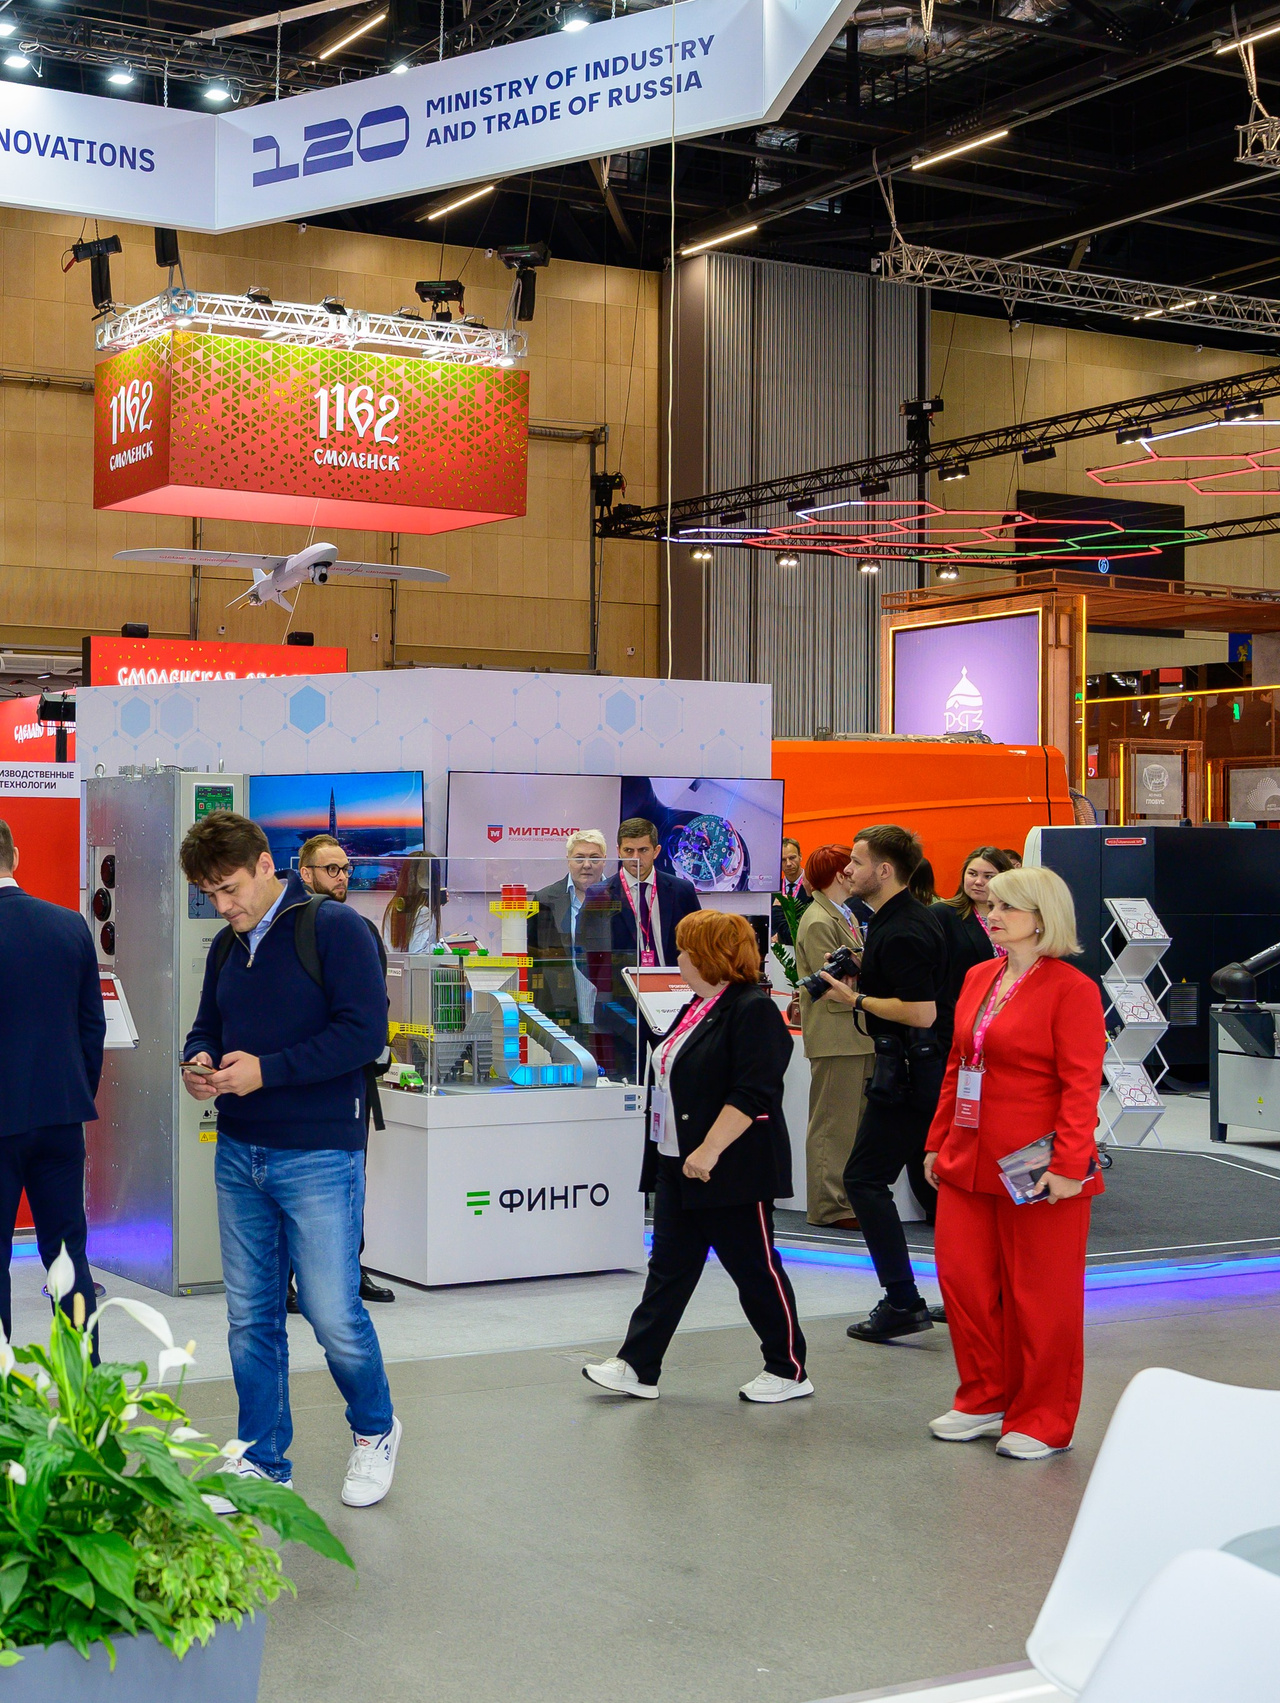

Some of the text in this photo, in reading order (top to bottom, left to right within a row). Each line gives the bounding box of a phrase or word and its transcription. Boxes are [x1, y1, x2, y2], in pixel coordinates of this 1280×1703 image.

[426, 34, 715, 118] MINISTRY OF INDUSTRY
[425, 70, 703, 148] AND TRADE OF RUSSIA
[252, 105, 410, 187] 120
[110, 379, 153, 445] 1162
[313, 380, 400, 445] 1162
[109, 440, 153, 471] СМОЛЕНСК
[314, 448, 400, 471] СМОЛЕНСК
[0, 781, 56, 789] ТЕХНОЛОГИИ
[499, 1183, 609, 1213] ФИНГО
